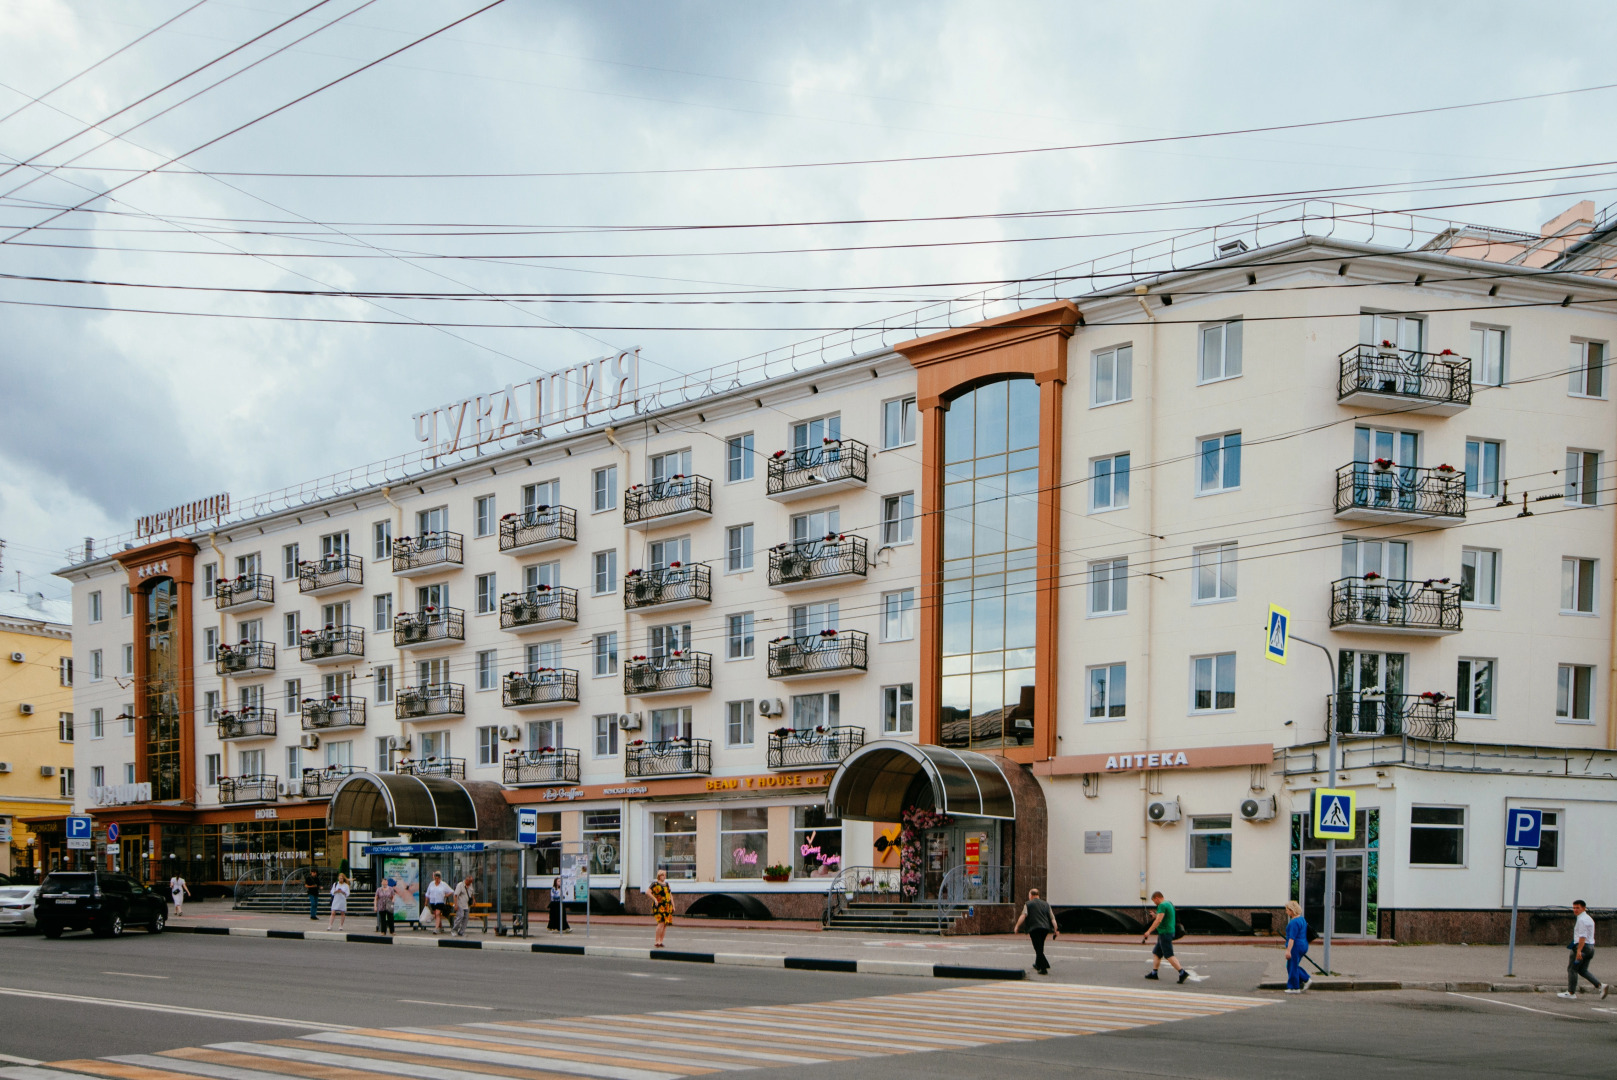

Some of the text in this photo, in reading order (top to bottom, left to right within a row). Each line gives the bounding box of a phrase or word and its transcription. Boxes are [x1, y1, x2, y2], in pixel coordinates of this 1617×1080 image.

[411, 344, 641, 459] ЧУВАШИЯ
[134, 491, 230, 540] ГОСТИНИЦА
[1105, 752, 1189, 769] АПТЕКА
[705, 778, 754, 790] BEAUTY
[758, 775, 802, 787] HOUSE
[806, 776, 819, 785] BY
[255, 808, 278, 819] HOTEL
[72, 819, 87, 836] P
[1514, 813, 1535, 842] P
